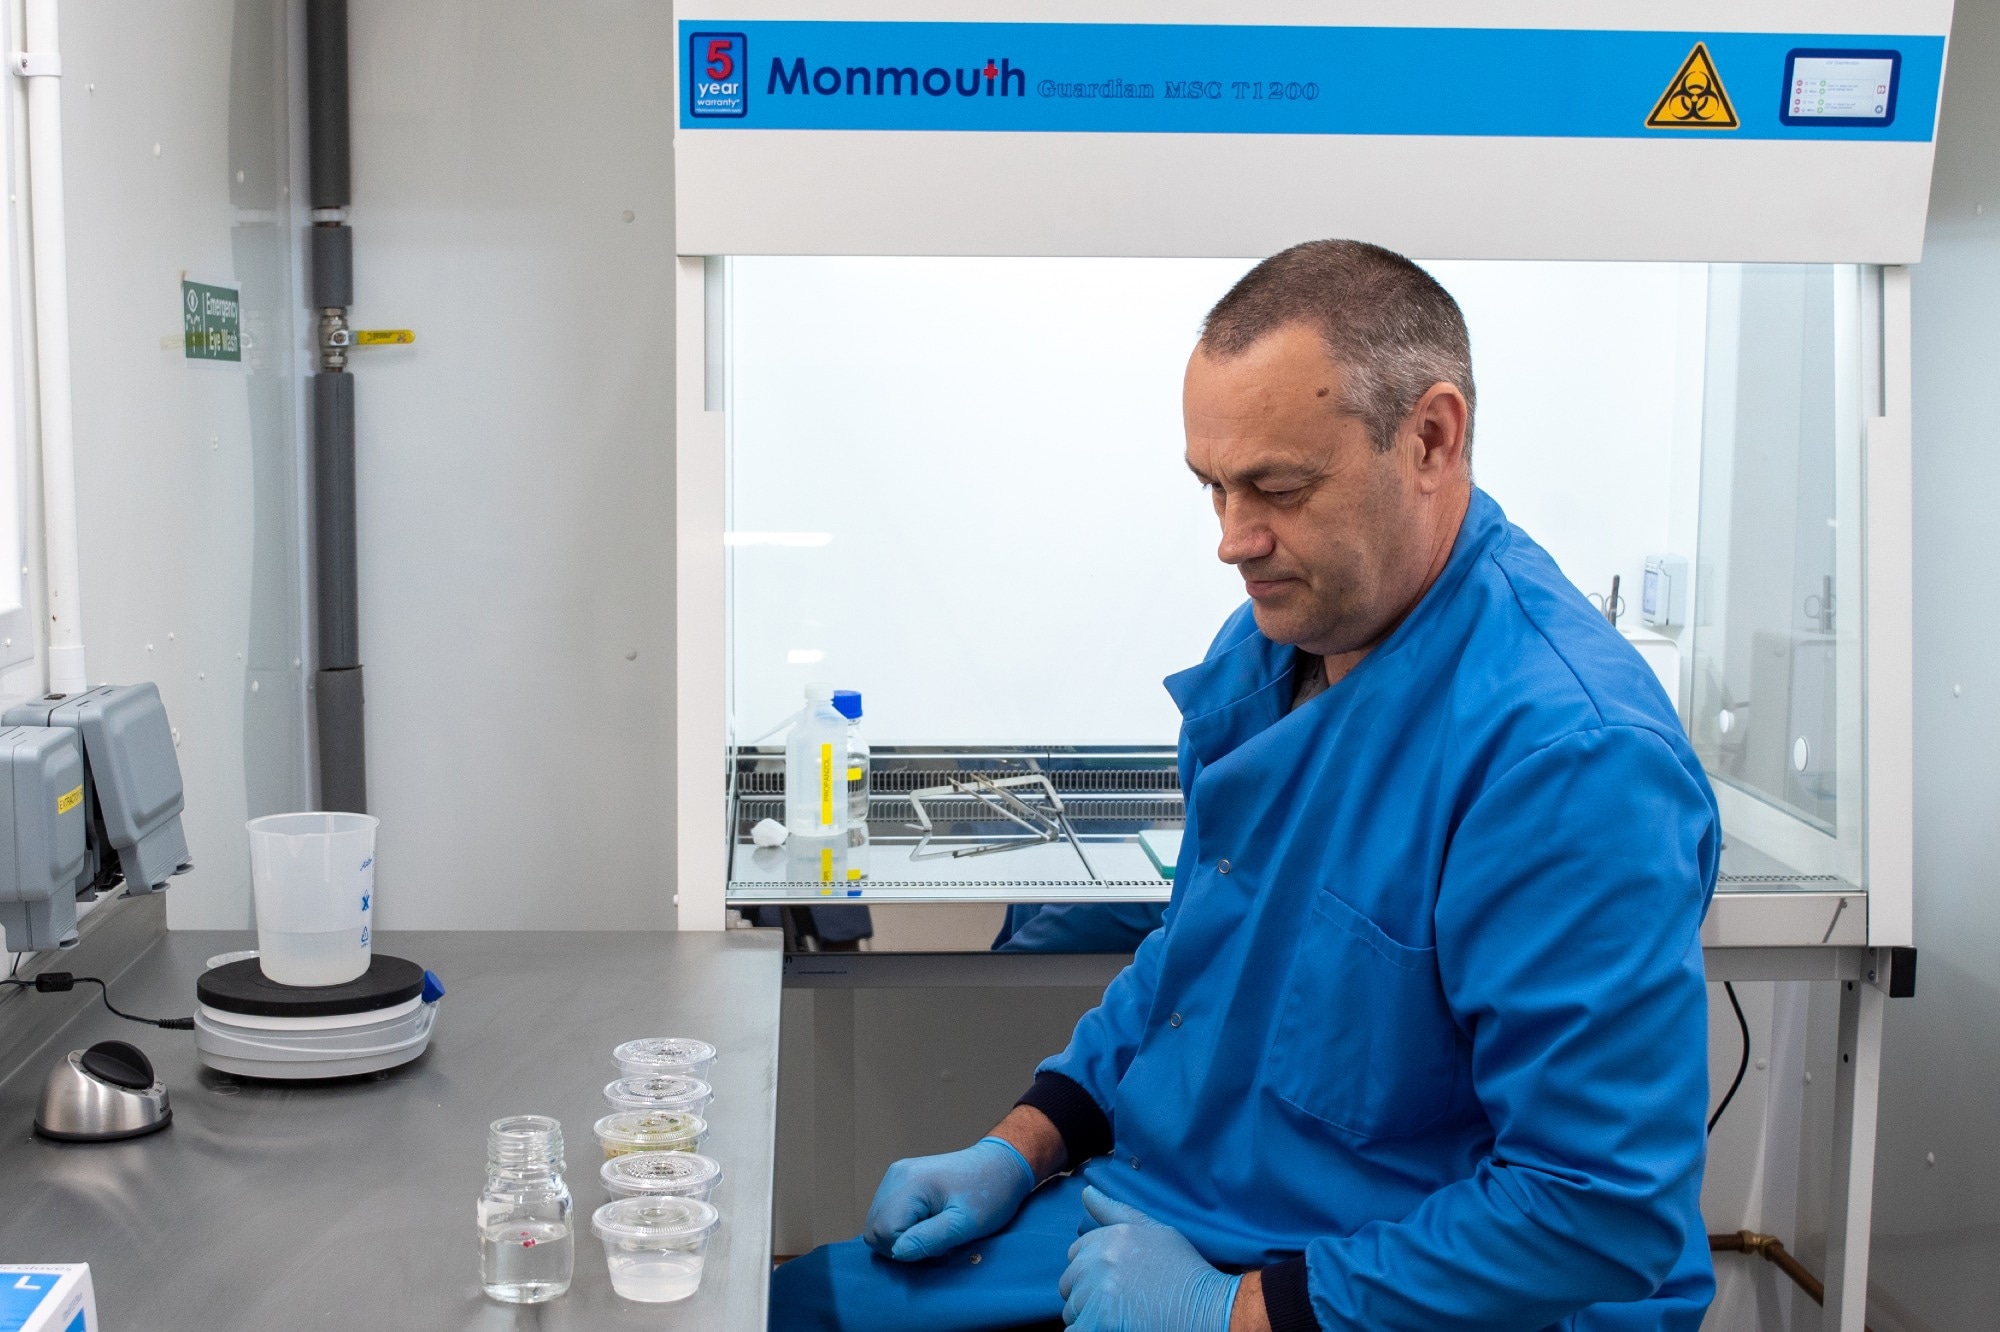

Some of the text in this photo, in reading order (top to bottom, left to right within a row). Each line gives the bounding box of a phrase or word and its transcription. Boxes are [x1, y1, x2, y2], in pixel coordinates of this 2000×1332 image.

[706, 39, 734, 81] 5
[698, 82, 739, 98] year
[767, 57, 1319, 101] Monmouth Guardian MSC T1200
[206, 292, 238, 325] Emergency
[209, 327, 238, 357] Eye Wash
[13, 1275, 42, 1290] L
